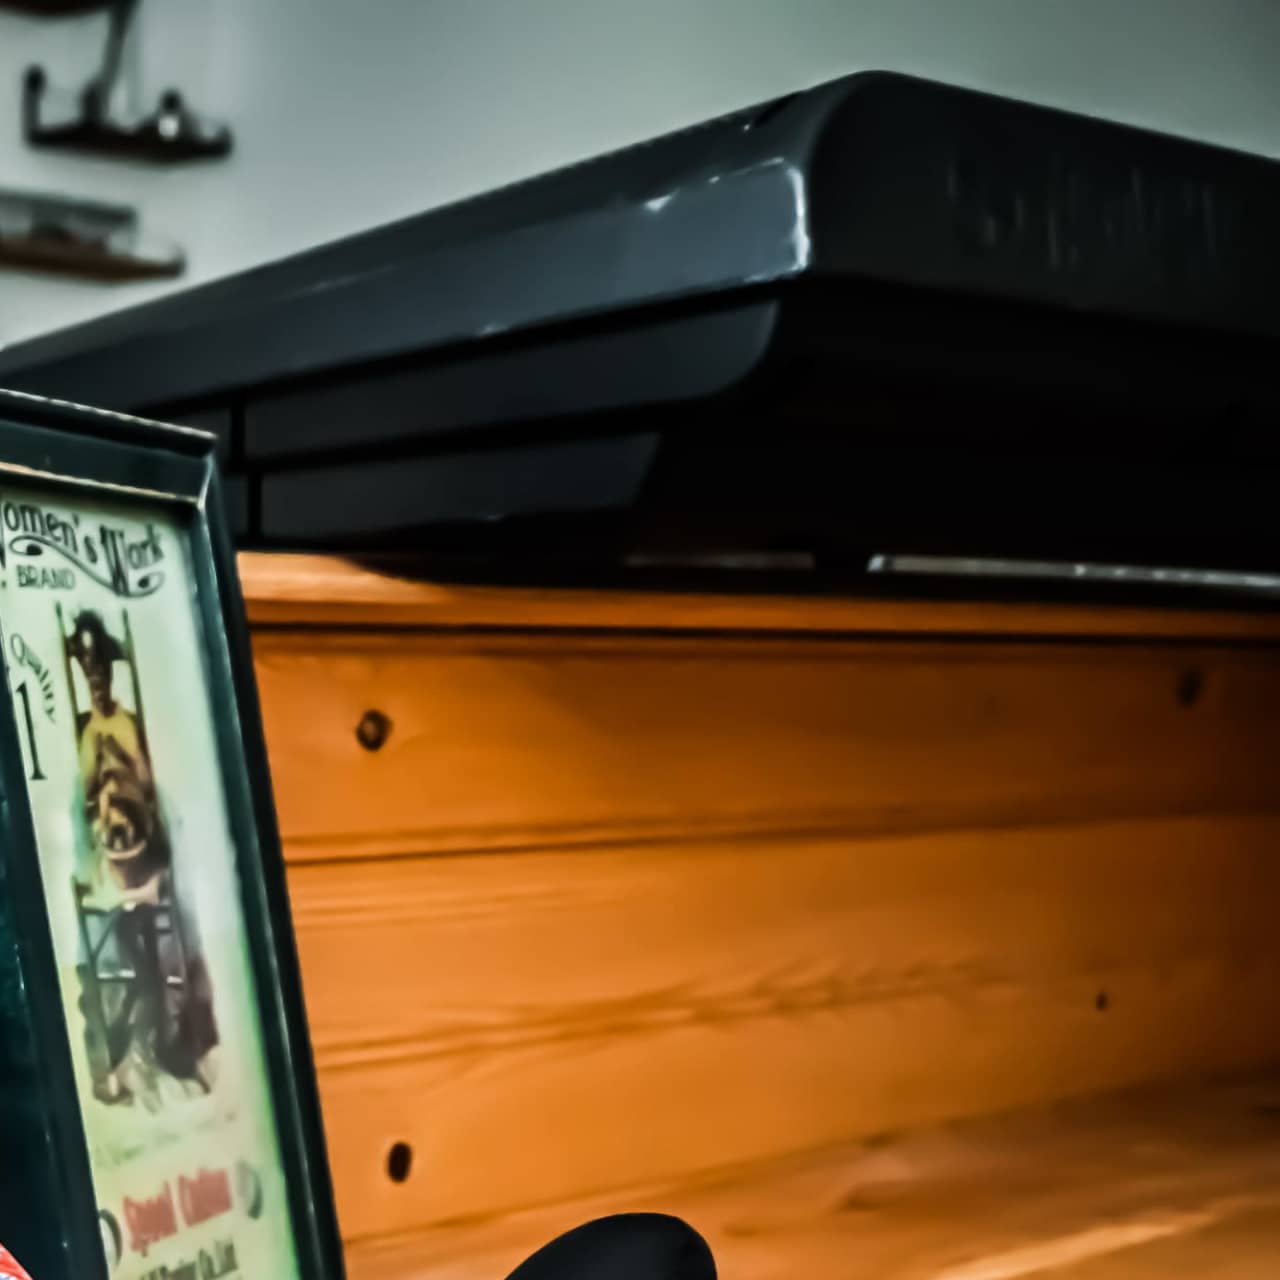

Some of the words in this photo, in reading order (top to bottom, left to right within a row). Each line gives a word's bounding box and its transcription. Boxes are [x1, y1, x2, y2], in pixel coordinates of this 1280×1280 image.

[16, 564, 76, 590] BRAND
[99, 523, 164, 598] Work
[16, 681, 47, 781] 1
